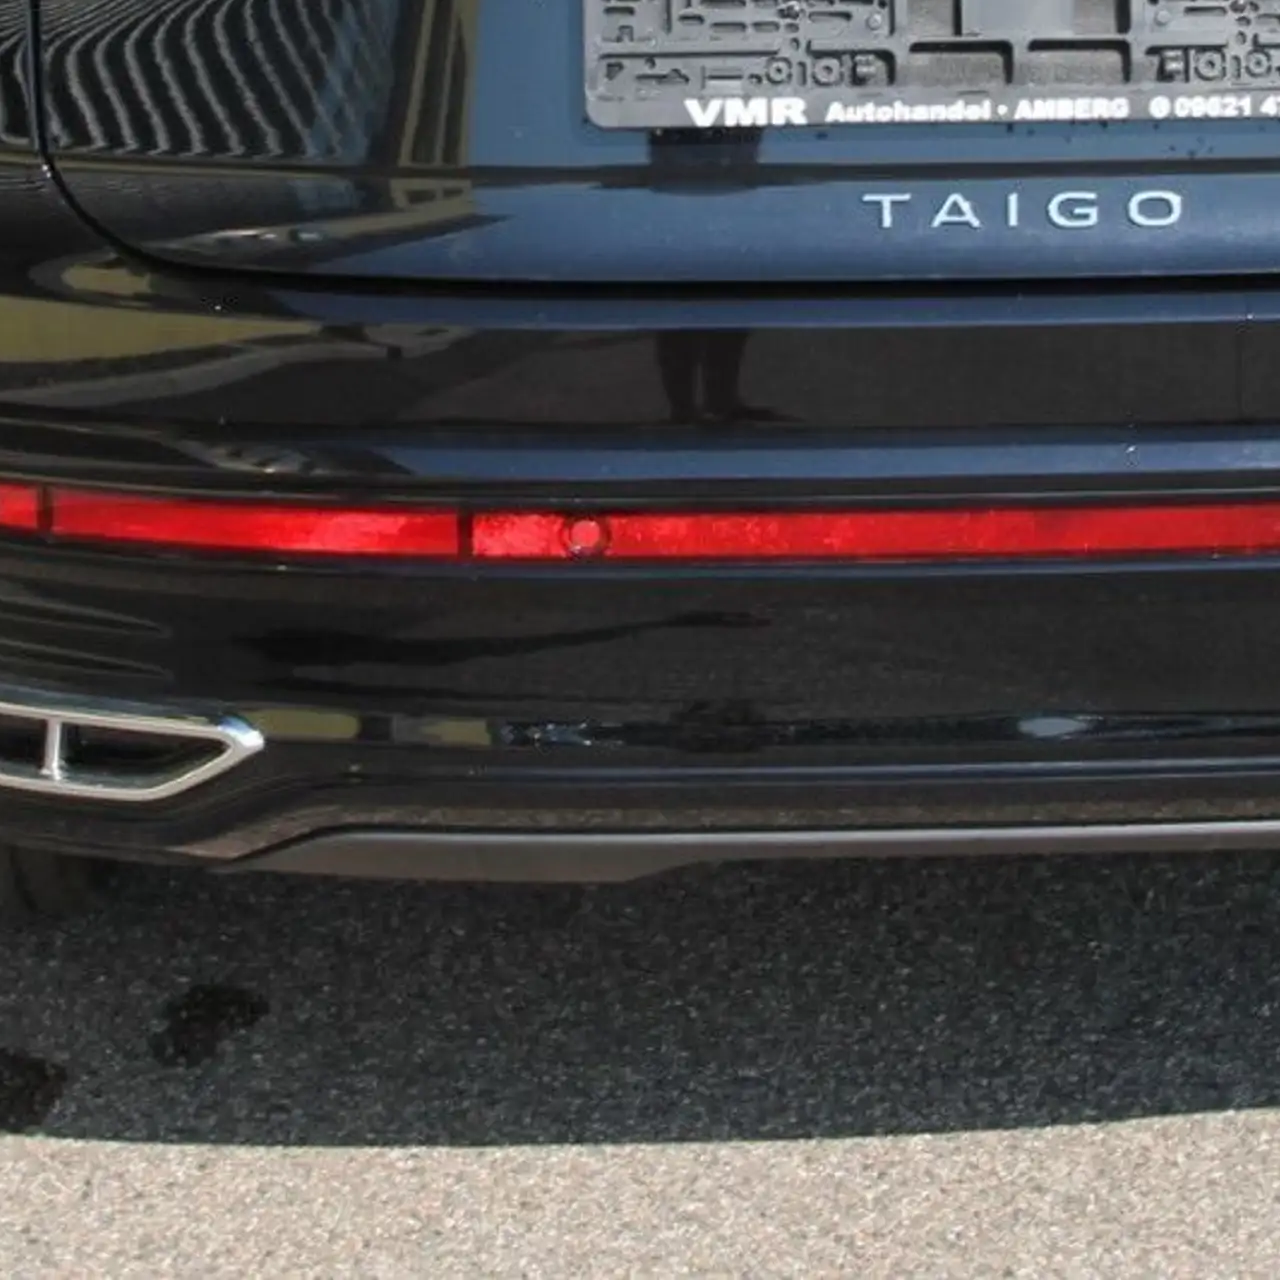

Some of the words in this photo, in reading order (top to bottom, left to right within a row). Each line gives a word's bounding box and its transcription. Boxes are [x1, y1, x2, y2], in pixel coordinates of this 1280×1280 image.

[684, 97, 808, 127] VMR
[825, 101, 992, 123] Autohandel
[1014, 98, 1130, 120] AMBERG
[861, 190, 1185, 230] TAIGO
